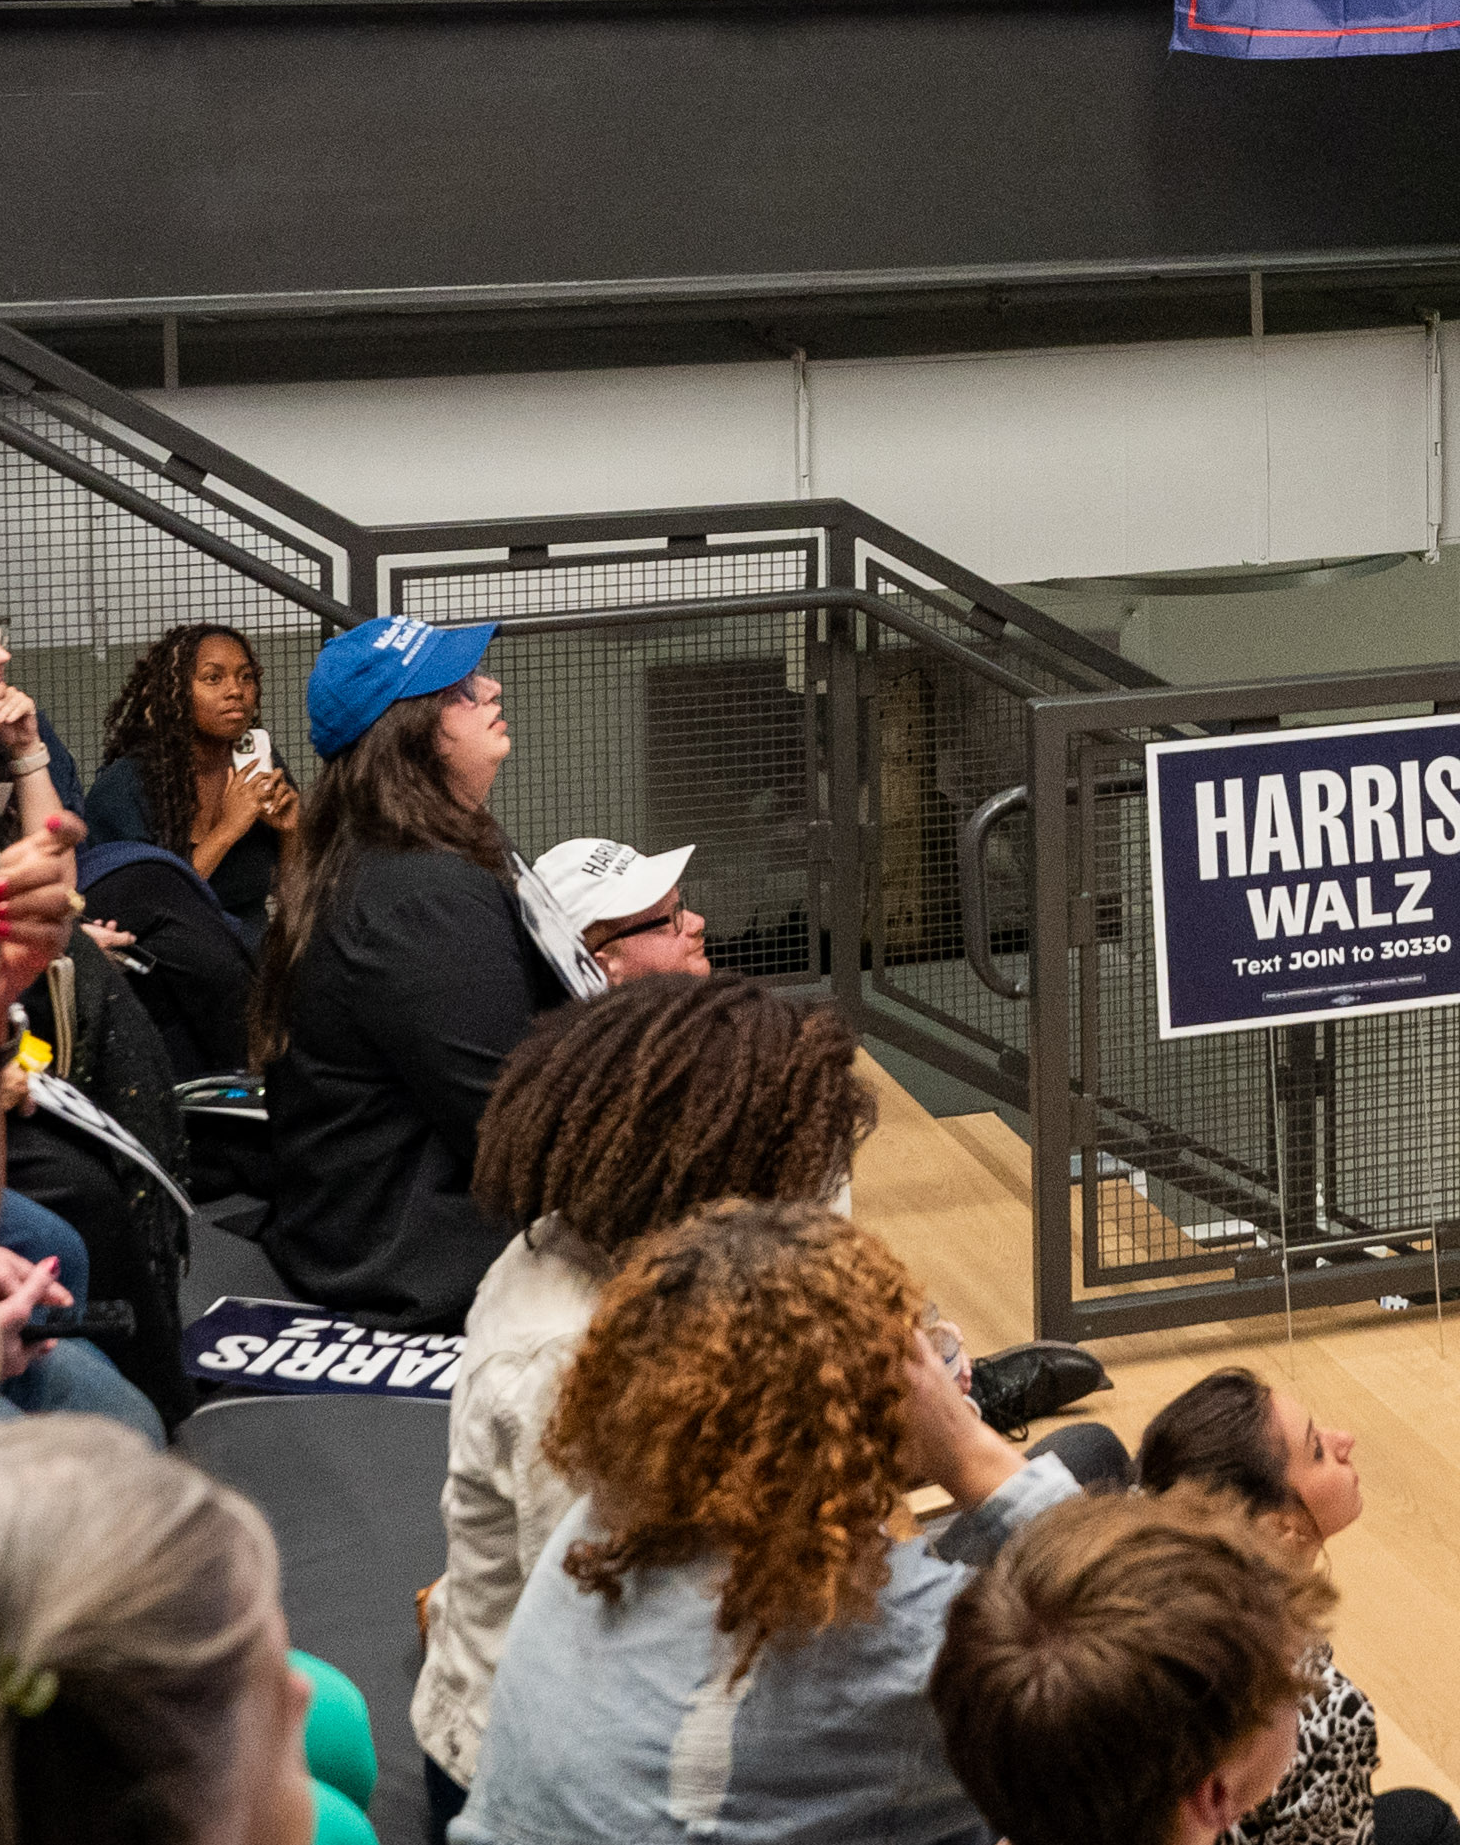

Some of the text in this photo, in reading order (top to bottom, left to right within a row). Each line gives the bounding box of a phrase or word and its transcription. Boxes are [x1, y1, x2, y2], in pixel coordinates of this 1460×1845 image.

[1245, 870, 1435, 942] WALZ
[1231, 934, 1452, 978] Text JOIN to 30330
